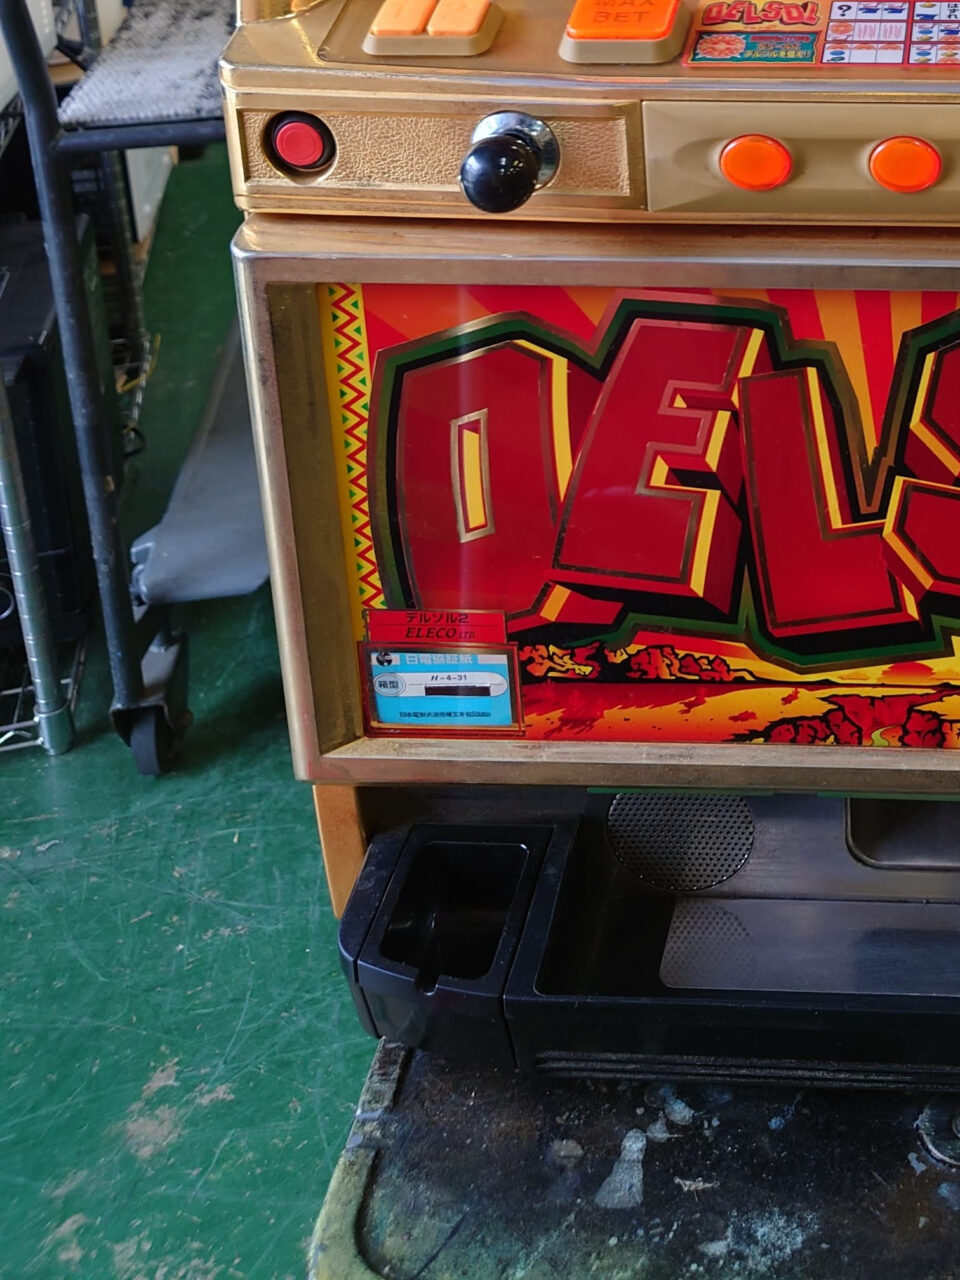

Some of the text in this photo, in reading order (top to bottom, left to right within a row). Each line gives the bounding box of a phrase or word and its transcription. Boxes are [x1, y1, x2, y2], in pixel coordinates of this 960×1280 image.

[592, 10, 650, 23] BET
[702, 0, 820, 26] DELSOL
[405, 627, 457, 639] ELECO
